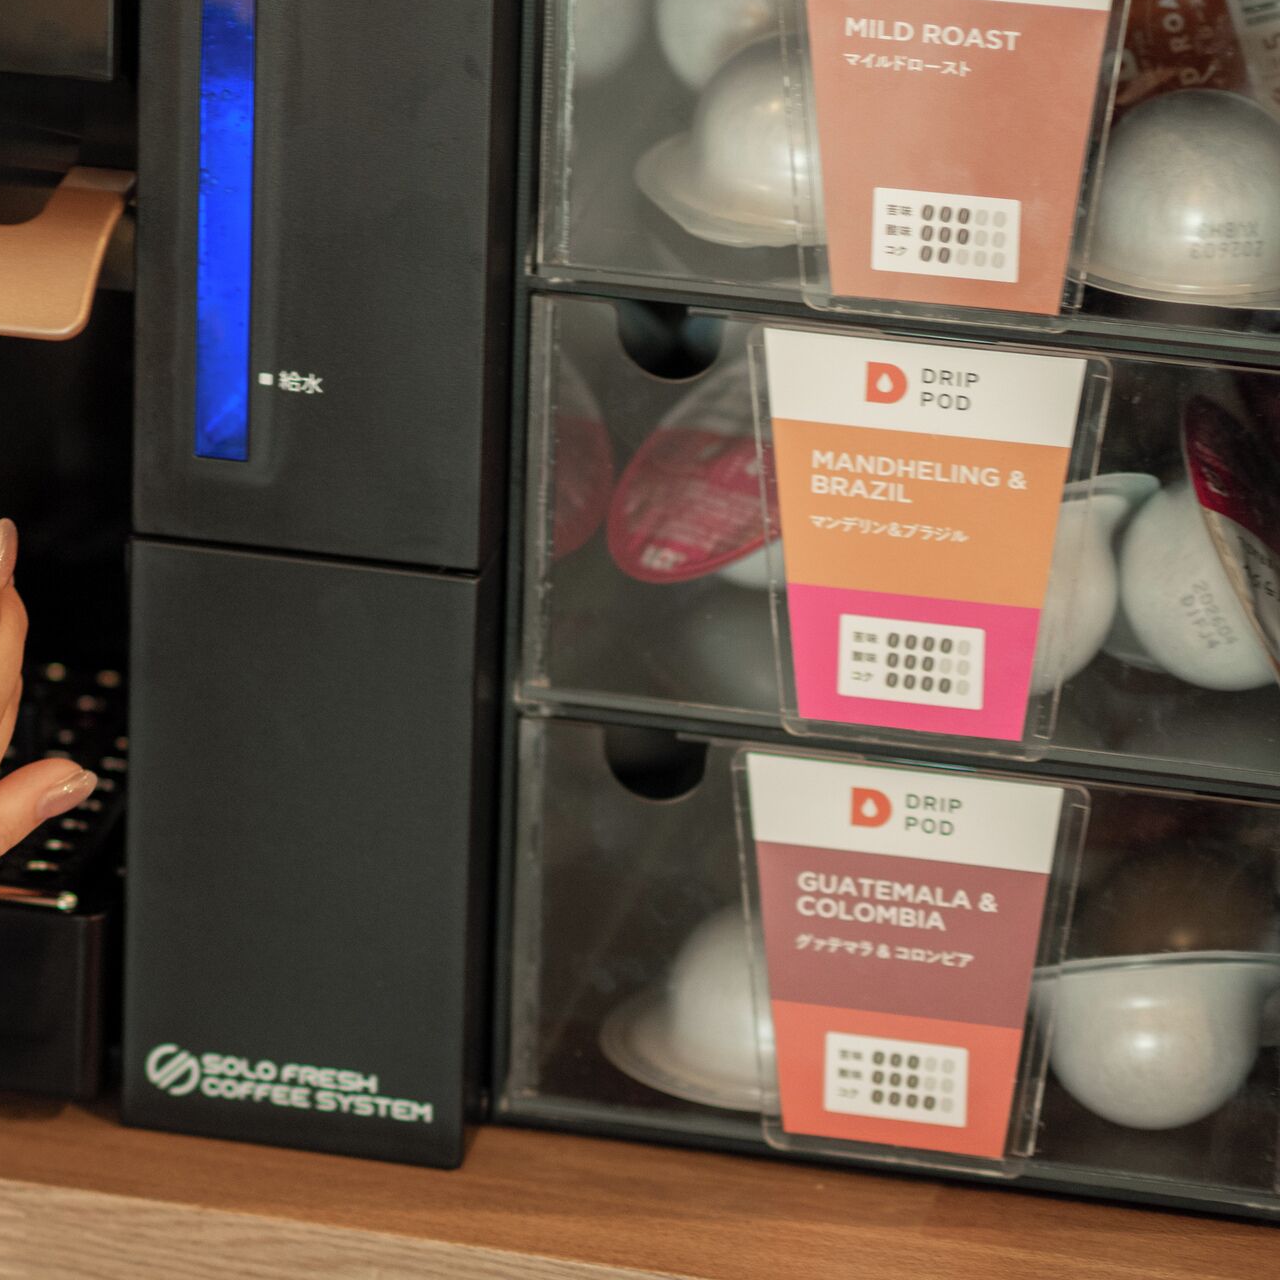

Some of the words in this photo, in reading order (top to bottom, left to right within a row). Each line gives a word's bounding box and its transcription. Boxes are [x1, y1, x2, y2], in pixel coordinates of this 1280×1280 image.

[845, 17, 915, 41] MILD
[922, 24, 1022, 51] ROAST
[843, 53, 972, 77] マイルドロースト
[278, 370, 323, 394] 給水
[921, 368, 980, 388] DRIP
[920, 391, 971, 411] POD
[811, 449, 1001, 488] MANDHELING
[1007, 470, 1028, 490] &
[810, 474, 913, 503] BRAZIL
[905, 793, 963, 814] DRIP
[904, 816, 955, 837] POD
[797, 871, 973, 910] GUATEMALA
[978, 892, 998, 913] &
[796, 895, 947, 932] COLOMBIA
[201, 1052, 277, 1082] SOLO
[281, 1063, 378, 1095] FRESH
[201, 1076, 312, 1109] COFFEE
[315, 1089, 433, 1124] SYSTEM
